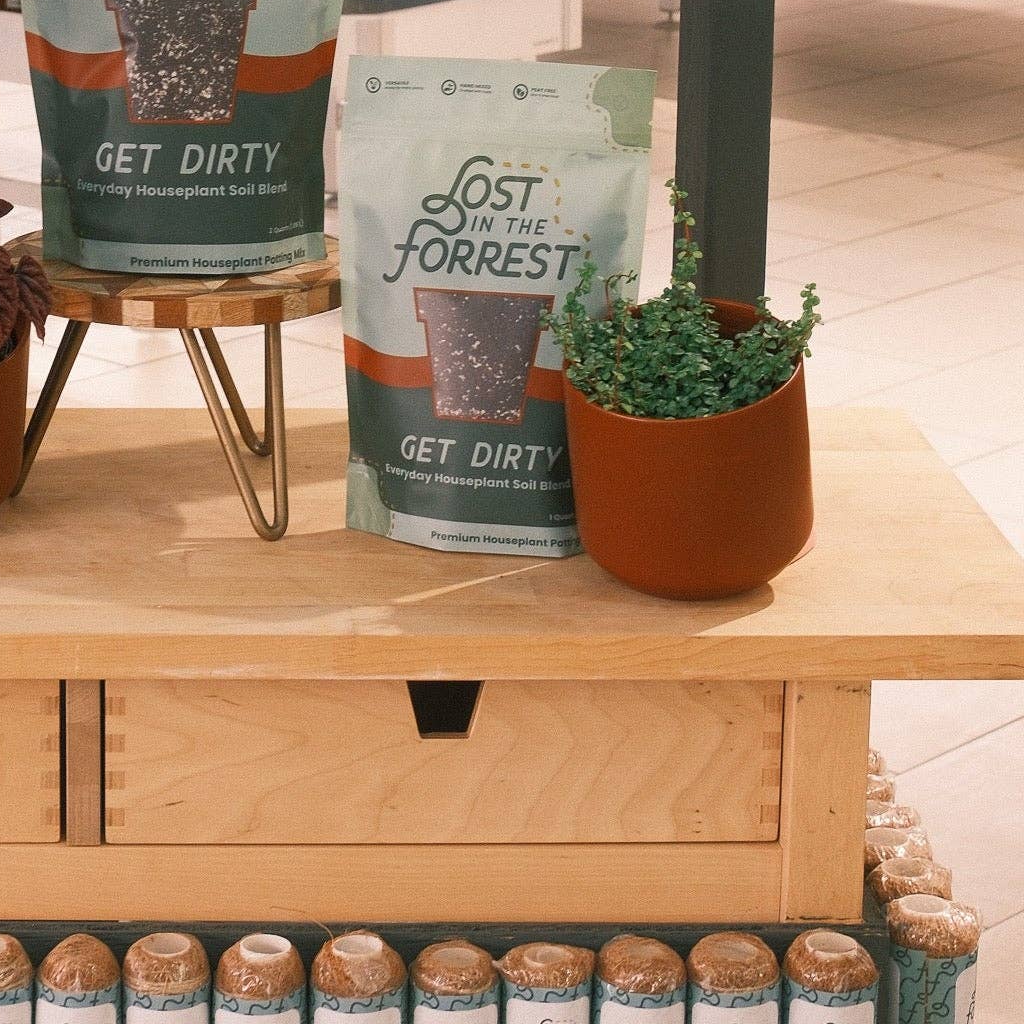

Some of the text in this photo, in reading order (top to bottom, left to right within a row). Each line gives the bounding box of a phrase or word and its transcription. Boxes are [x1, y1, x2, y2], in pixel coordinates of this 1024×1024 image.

[95, 142, 281, 175] GET DIRTY
[77, 179, 288, 200] Everyday Houseplant Soil Blend
[422, 155, 543, 215] LOST
[470, 216, 548, 235] IN THE
[130, 256, 189, 268] Premium
[192, 255, 263, 270] Houseplant
[383, 218, 580, 283] FORREST
[400, 434, 566, 472] GET DIRTY
[385, 463, 432, 484] Everyday
[434, 473, 509, 490] Houseplant
[513, 478, 536, 491] Soil
[431, 530, 480, 543] Premium
[483, 534, 549, 549] Houseplant
